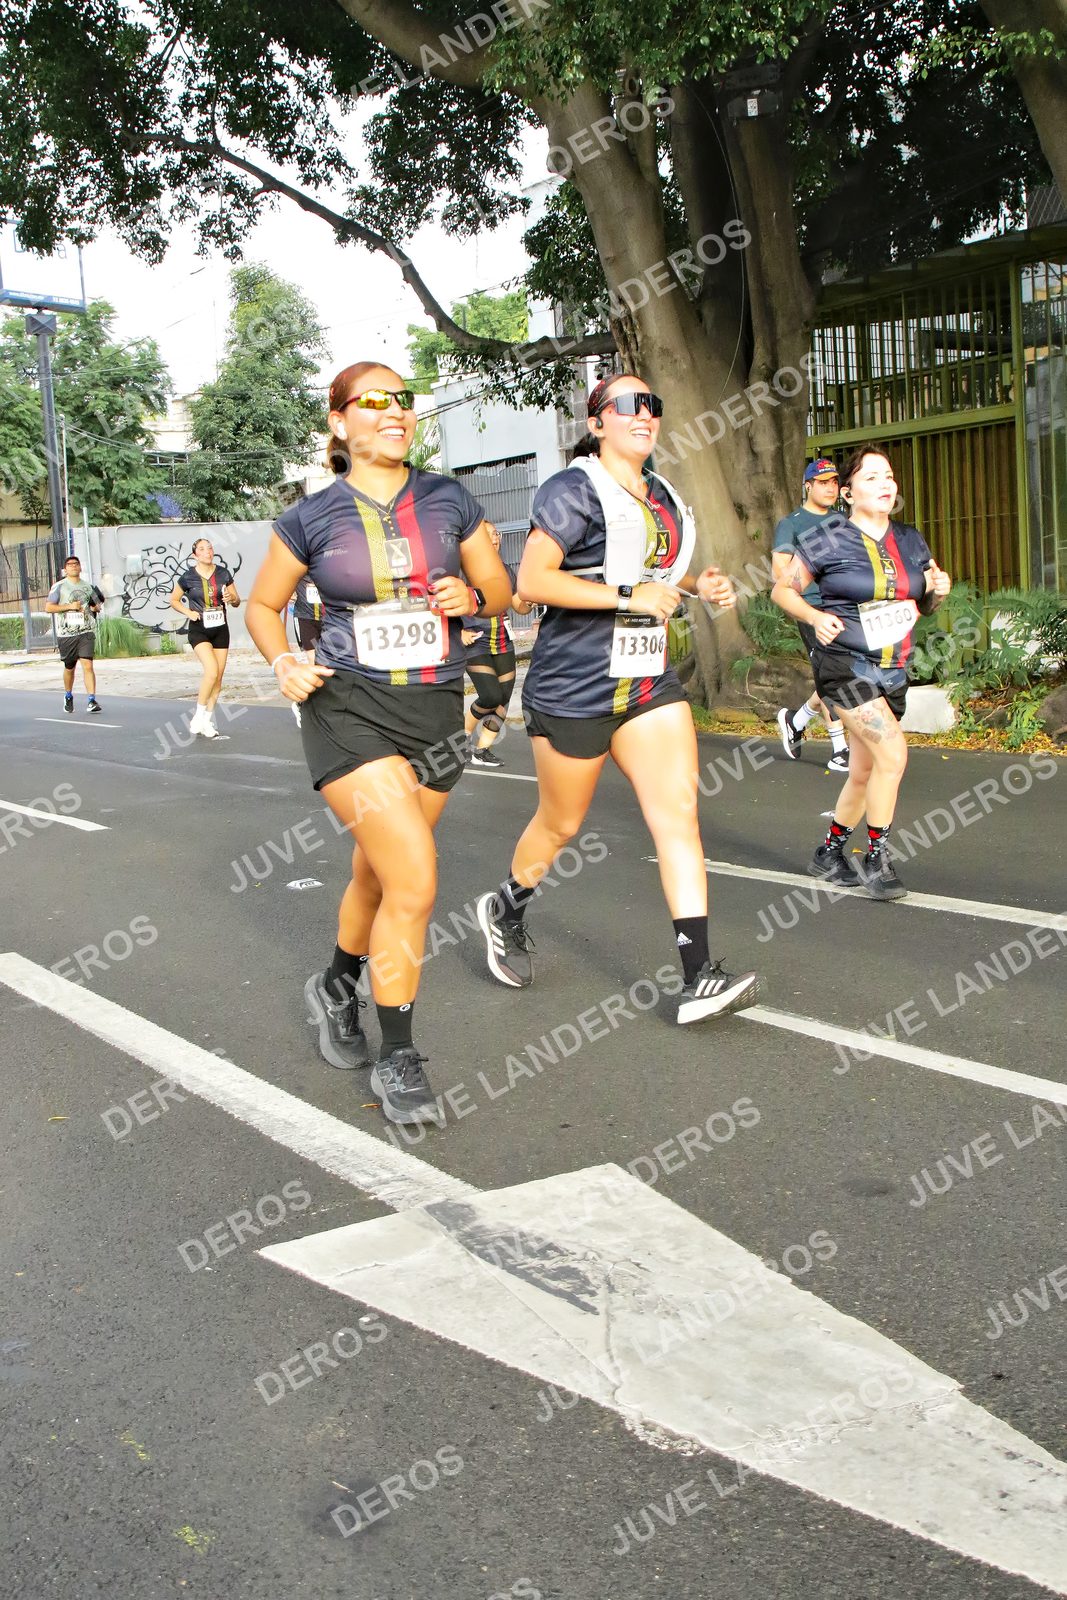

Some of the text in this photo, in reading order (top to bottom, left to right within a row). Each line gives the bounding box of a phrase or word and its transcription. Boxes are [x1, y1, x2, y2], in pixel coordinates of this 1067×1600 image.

[142, 542, 183, 559] TOY
[361, 620, 437, 652] 13298
[618, 633, 665, 656] 13306
